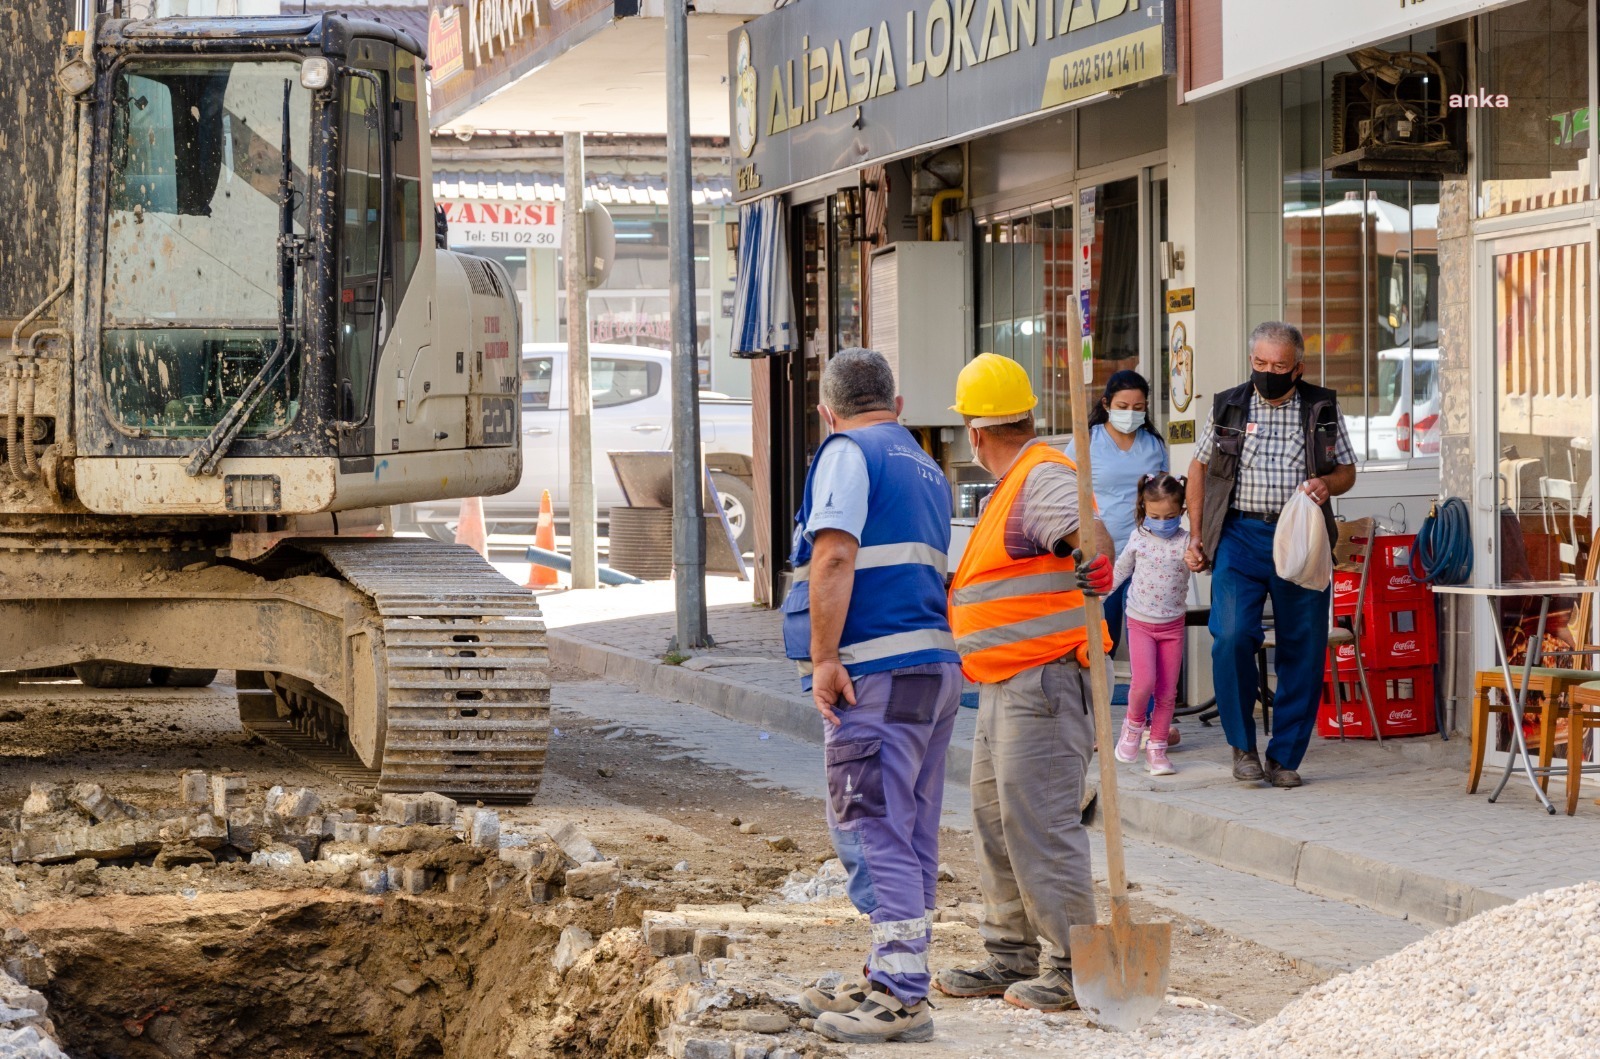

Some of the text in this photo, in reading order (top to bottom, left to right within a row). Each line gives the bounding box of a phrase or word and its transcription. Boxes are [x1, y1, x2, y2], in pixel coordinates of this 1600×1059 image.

[906, 0, 1139, 87] LOKAN
[1063, 41, 1145, 91] 0.232 512 14 11
[465, 230, 555, 244] Tel: 511 02 30
